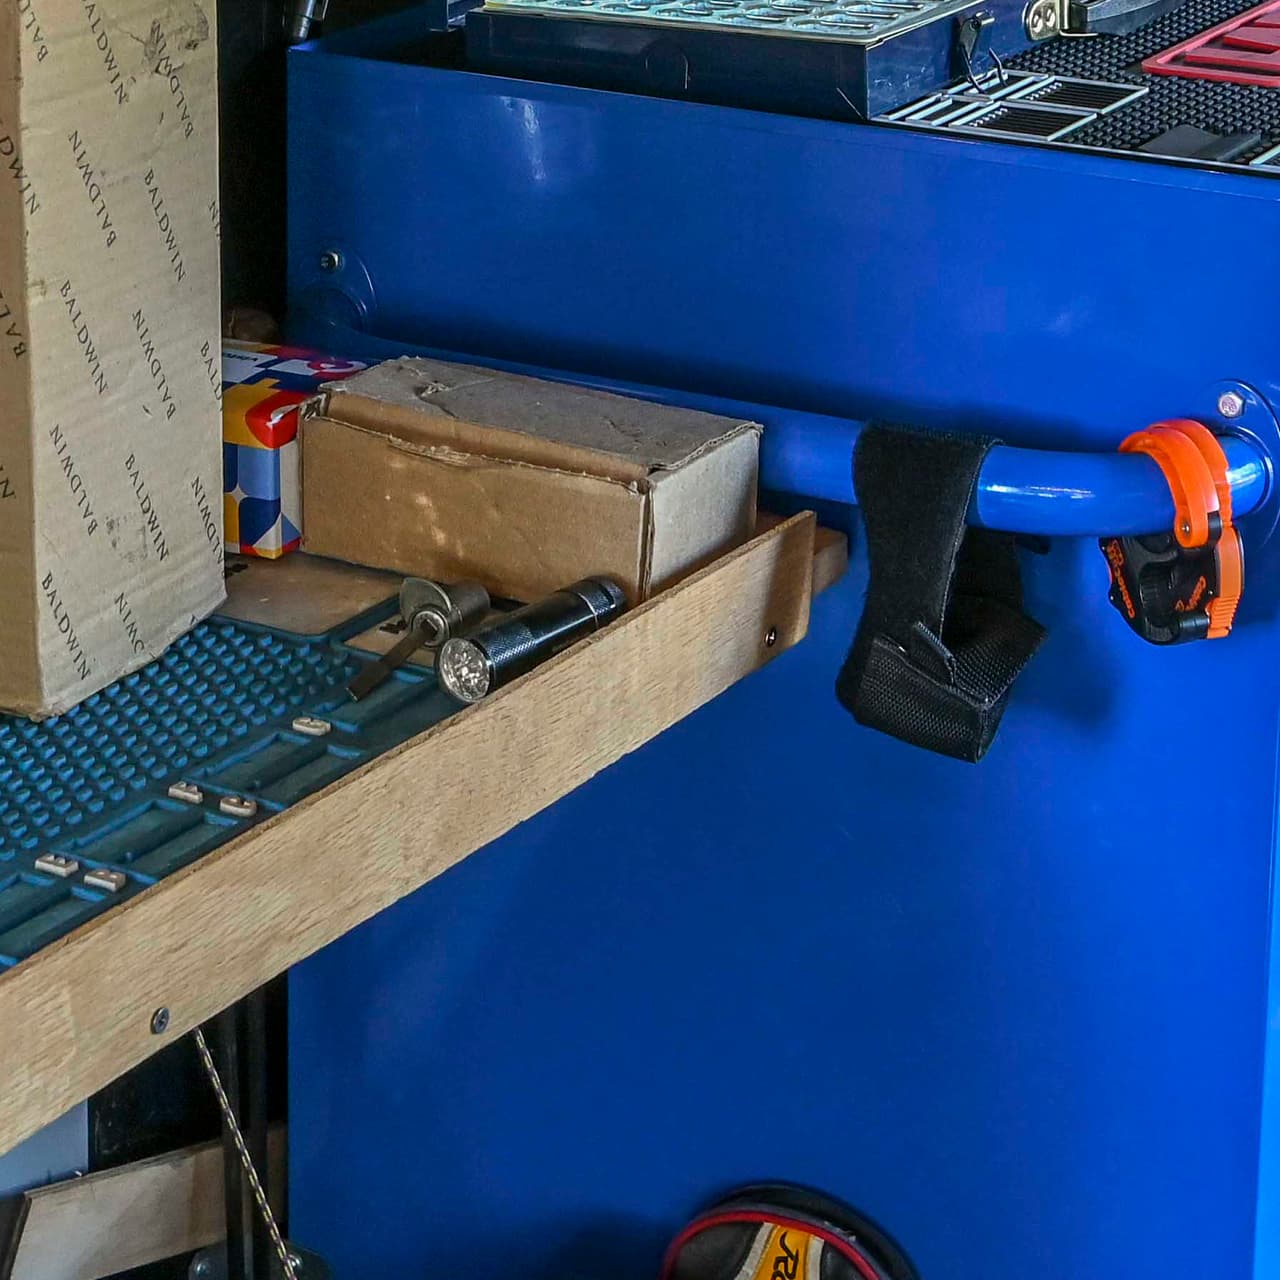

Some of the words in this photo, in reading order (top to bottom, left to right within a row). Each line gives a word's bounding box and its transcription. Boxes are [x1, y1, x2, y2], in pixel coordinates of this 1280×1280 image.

[69, 129, 118, 249] BALDWIN
[144, 168, 187, 284] BALDWIN
[60, 279, 109, 396] BALDWIN
[132, 309, 177, 421] BALDWIN
[50, 423, 98, 537] BALDWIN
[125, 454, 169, 563] BALDWIN
[41, 571, 92, 681] BALDWIN
